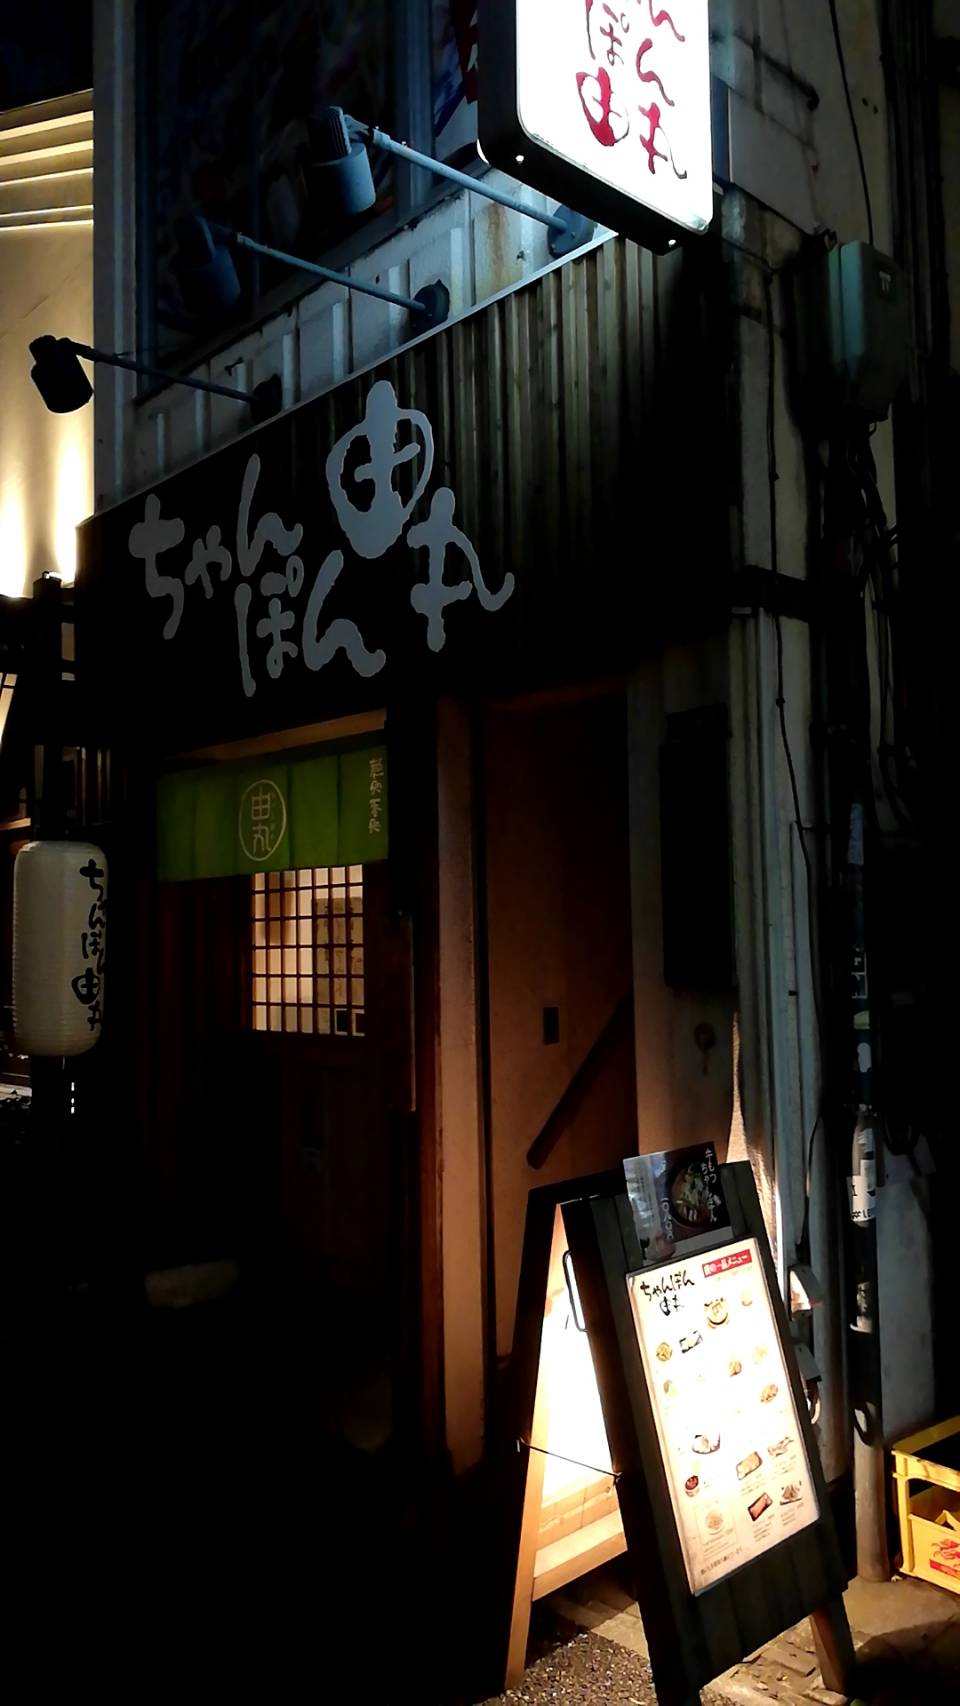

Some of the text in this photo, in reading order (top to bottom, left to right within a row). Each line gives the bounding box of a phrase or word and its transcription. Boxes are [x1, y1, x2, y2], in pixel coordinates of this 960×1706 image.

[250, 784, 273, 856] 由丸
[640, 1270, 695, 1302] ちゃんぽん
